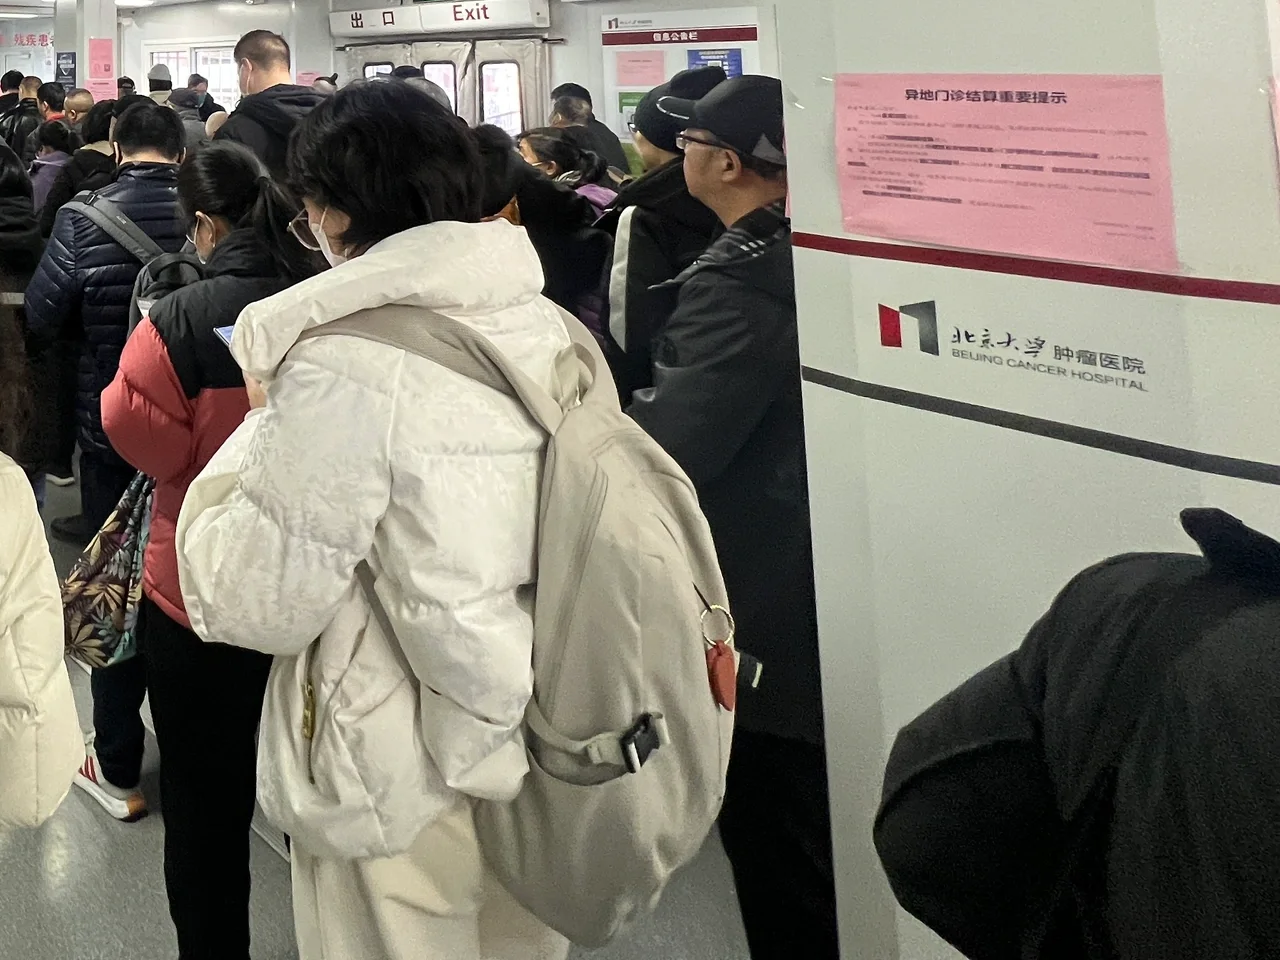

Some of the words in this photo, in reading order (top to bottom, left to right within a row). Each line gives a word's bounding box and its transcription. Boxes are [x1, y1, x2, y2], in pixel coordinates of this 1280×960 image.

[351, 12, 395, 28] 出口
[453, 3, 489, 21] Exit
[14, 32, 54, 47] 残疾患
[905, 89, 1068, 104] 异地门诊结算重要提示
[951, 326, 1046, 358] 北京大学
[1054, 345, 1146, 375] 肿瘤医院
[952, 348, 1004, 366] BEIJING
[1006, 358, 1068, 377] CANCER
[1071, 371, 1149, 392] HOSPITAL
